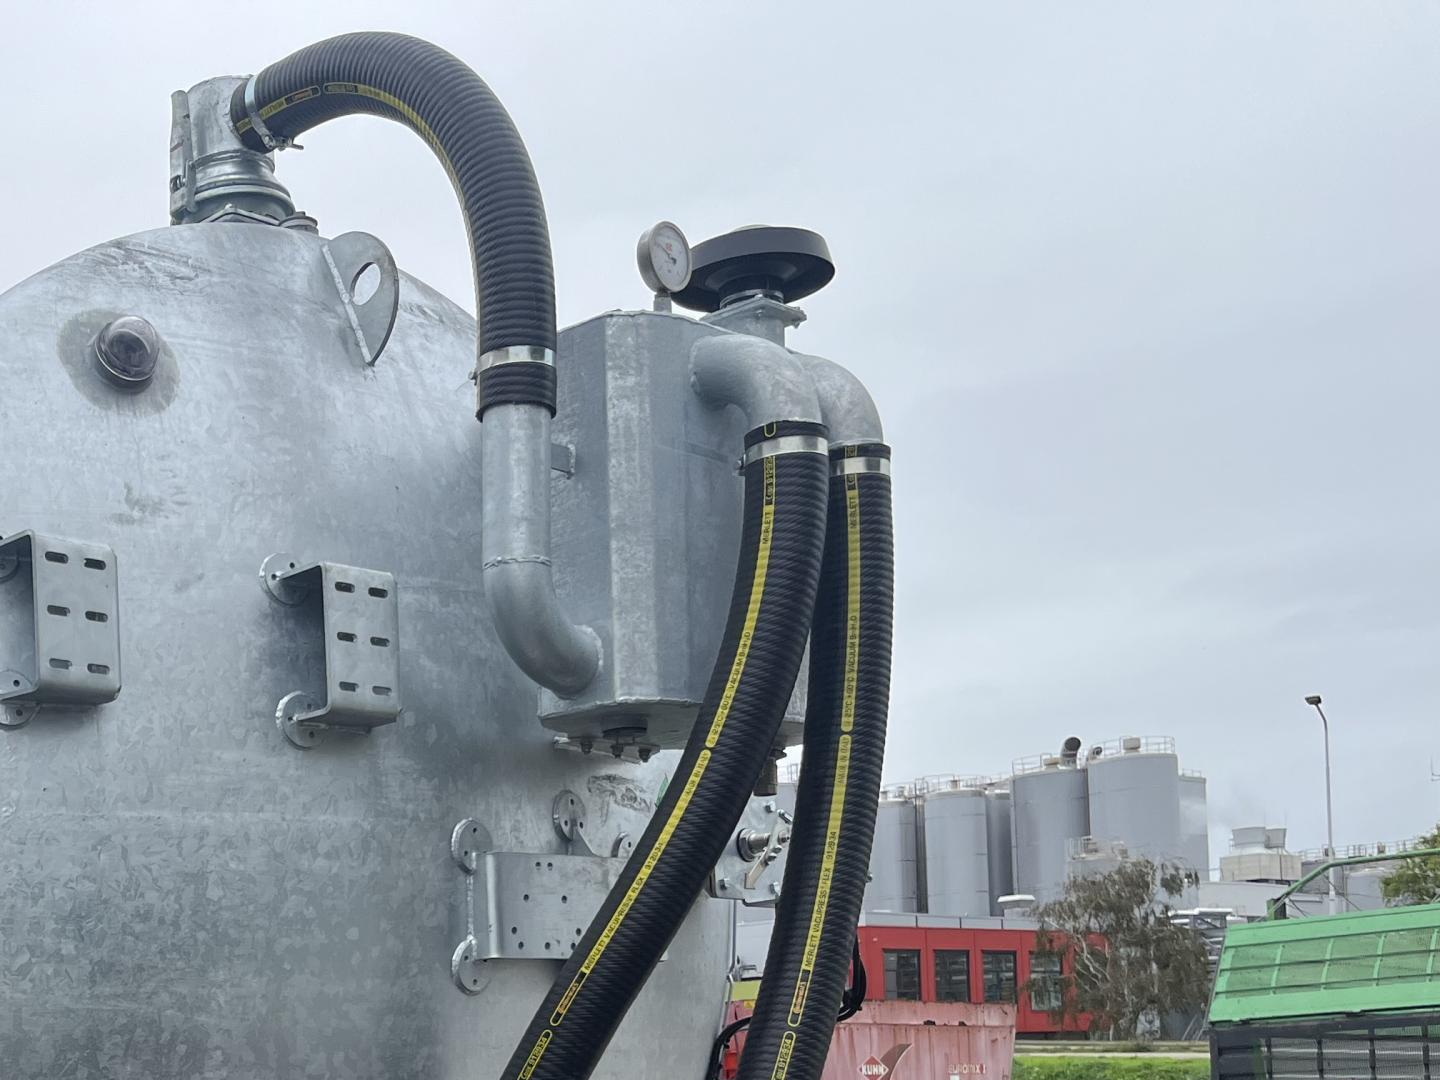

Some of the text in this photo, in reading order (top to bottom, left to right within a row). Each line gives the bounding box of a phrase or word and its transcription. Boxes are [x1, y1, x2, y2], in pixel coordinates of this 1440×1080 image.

[763, 512, 772, 545] MERLETT
[849, 497, 857, 529] MERLETT
[728, 657, 744, 689] VACUUM
[847, 641, 857, 673] VACUUM
[805, 935, 817, 968] MERLETT
[822, 867, 832, 885] FLEX
[585, 939, 605, 971] MERLETT
[862, 1065, 885, 1075] KUHN
